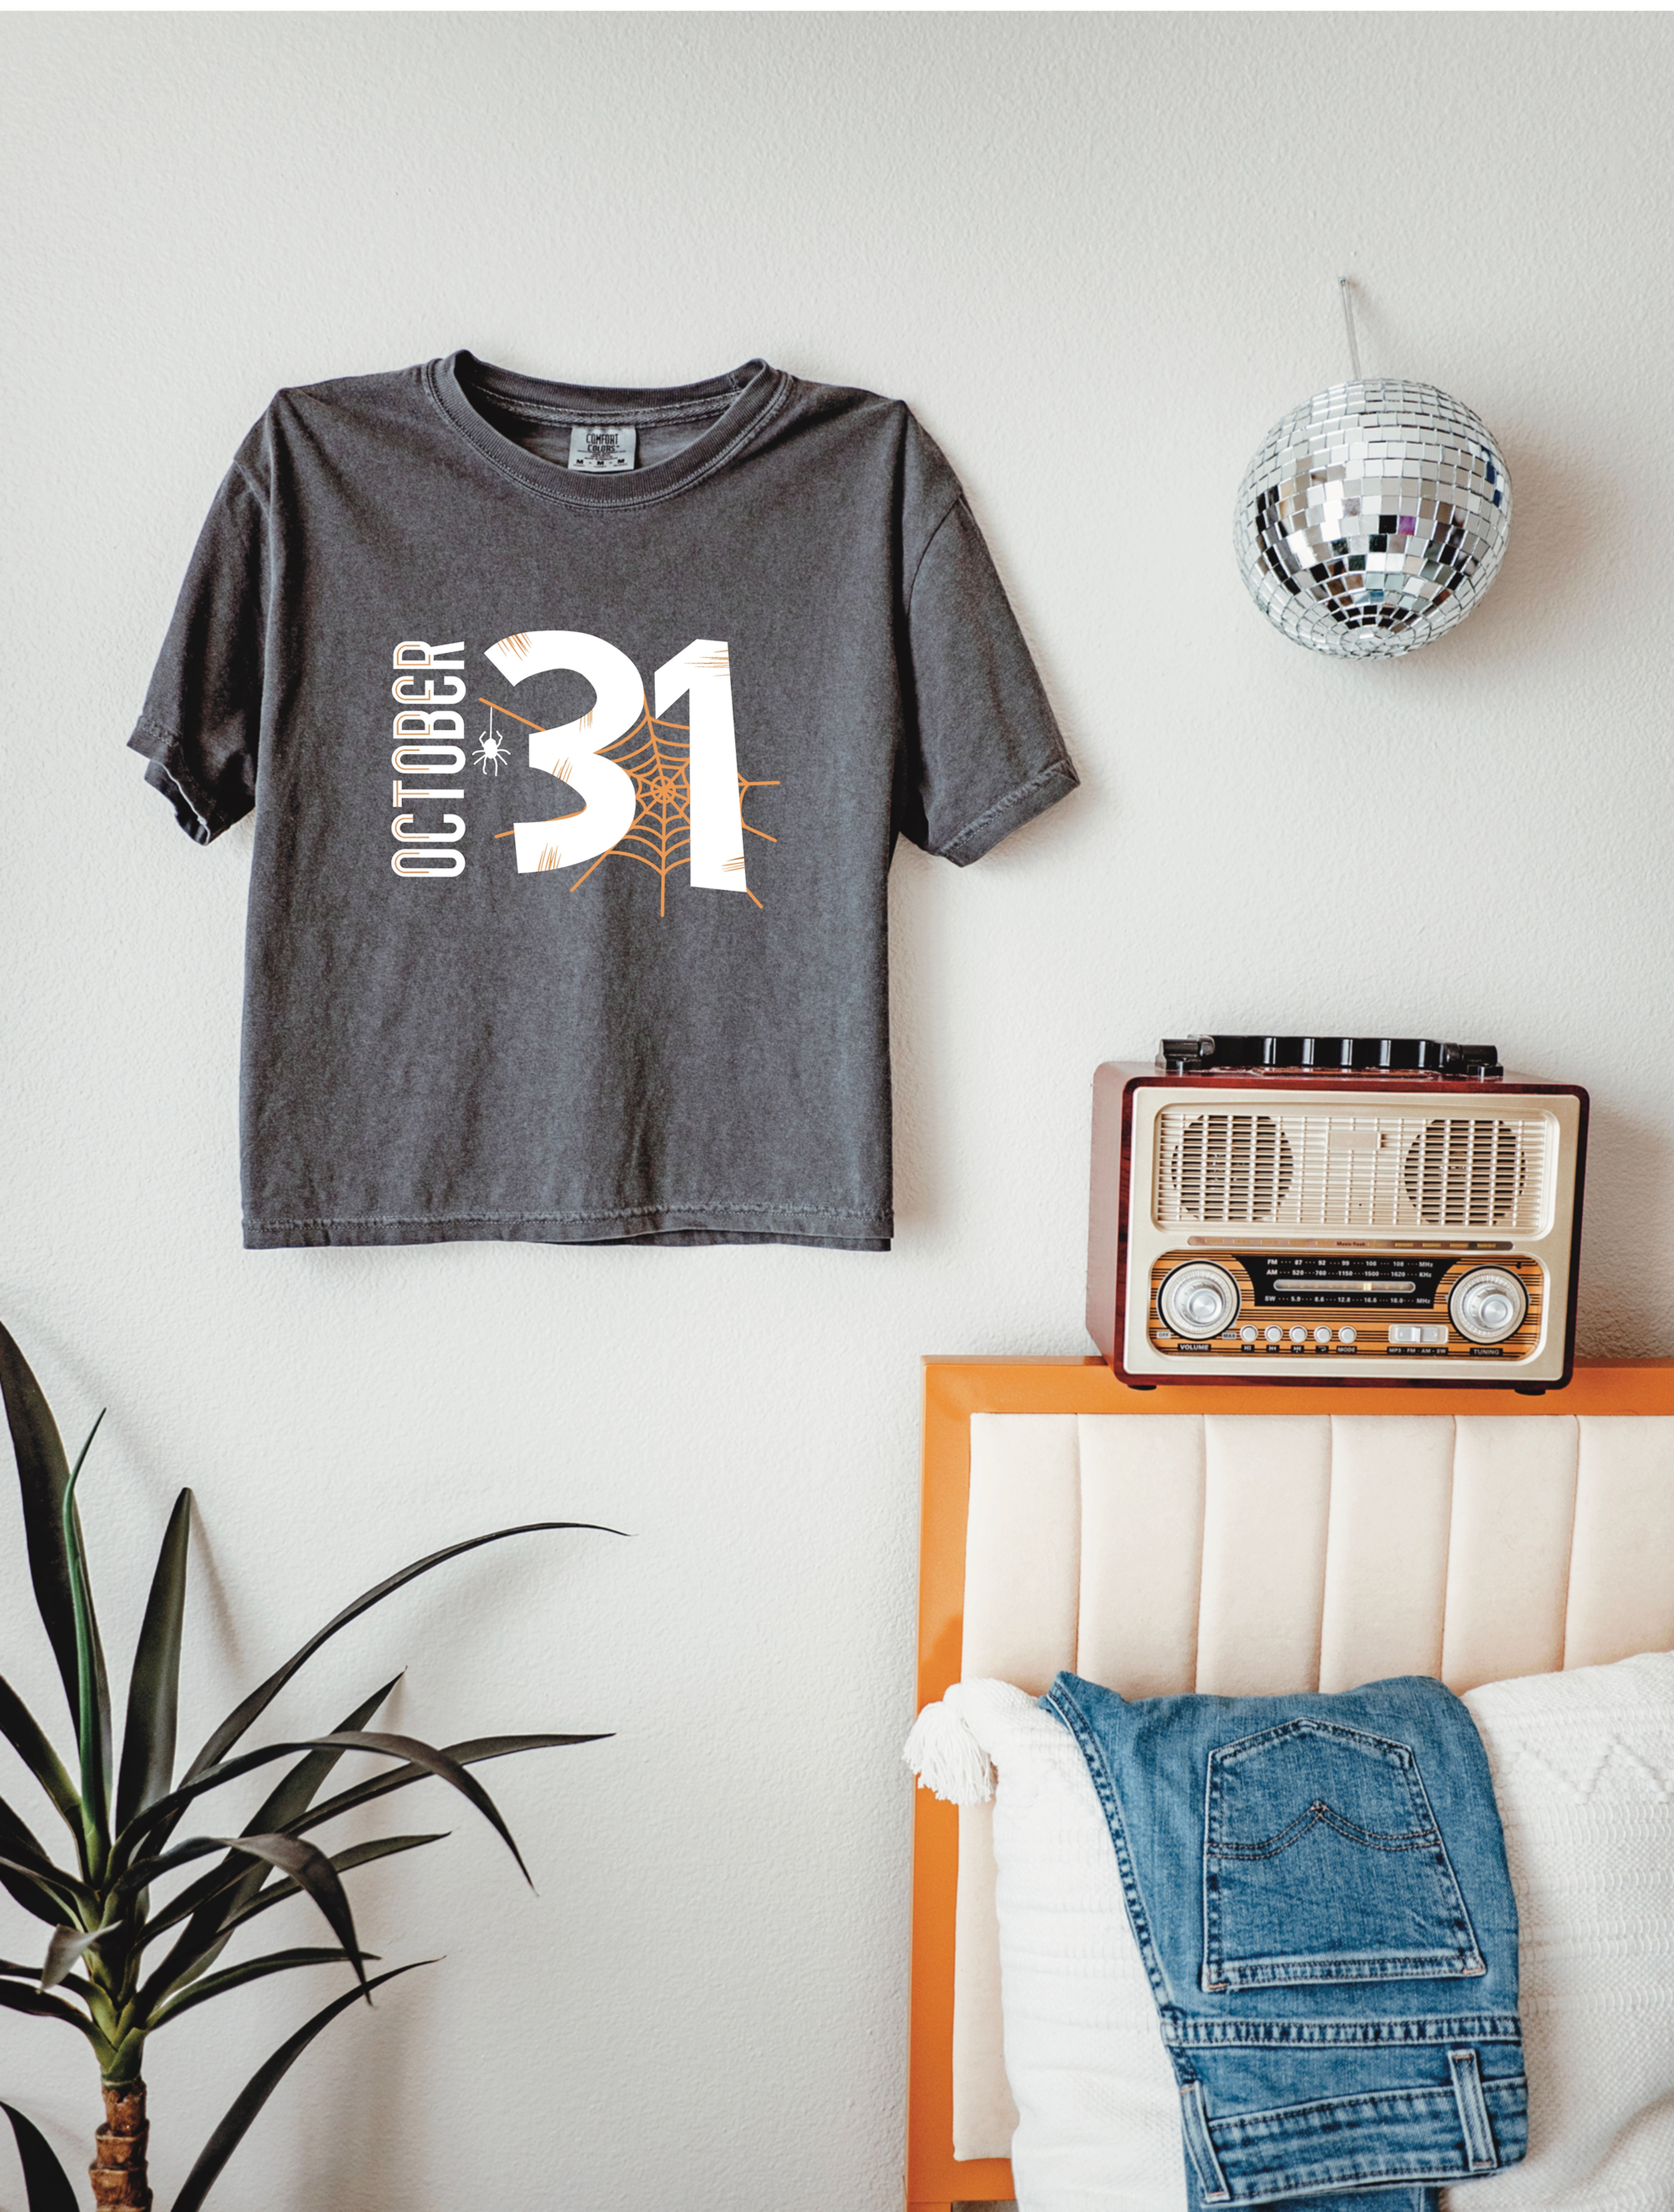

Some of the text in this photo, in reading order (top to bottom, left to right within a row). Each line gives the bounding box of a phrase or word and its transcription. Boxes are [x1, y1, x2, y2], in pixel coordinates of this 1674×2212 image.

[586, 433, 618, 444] COMFORT
[391, 641, 466, 877] OCTOBER
[484, 630, 747, 893] 31
